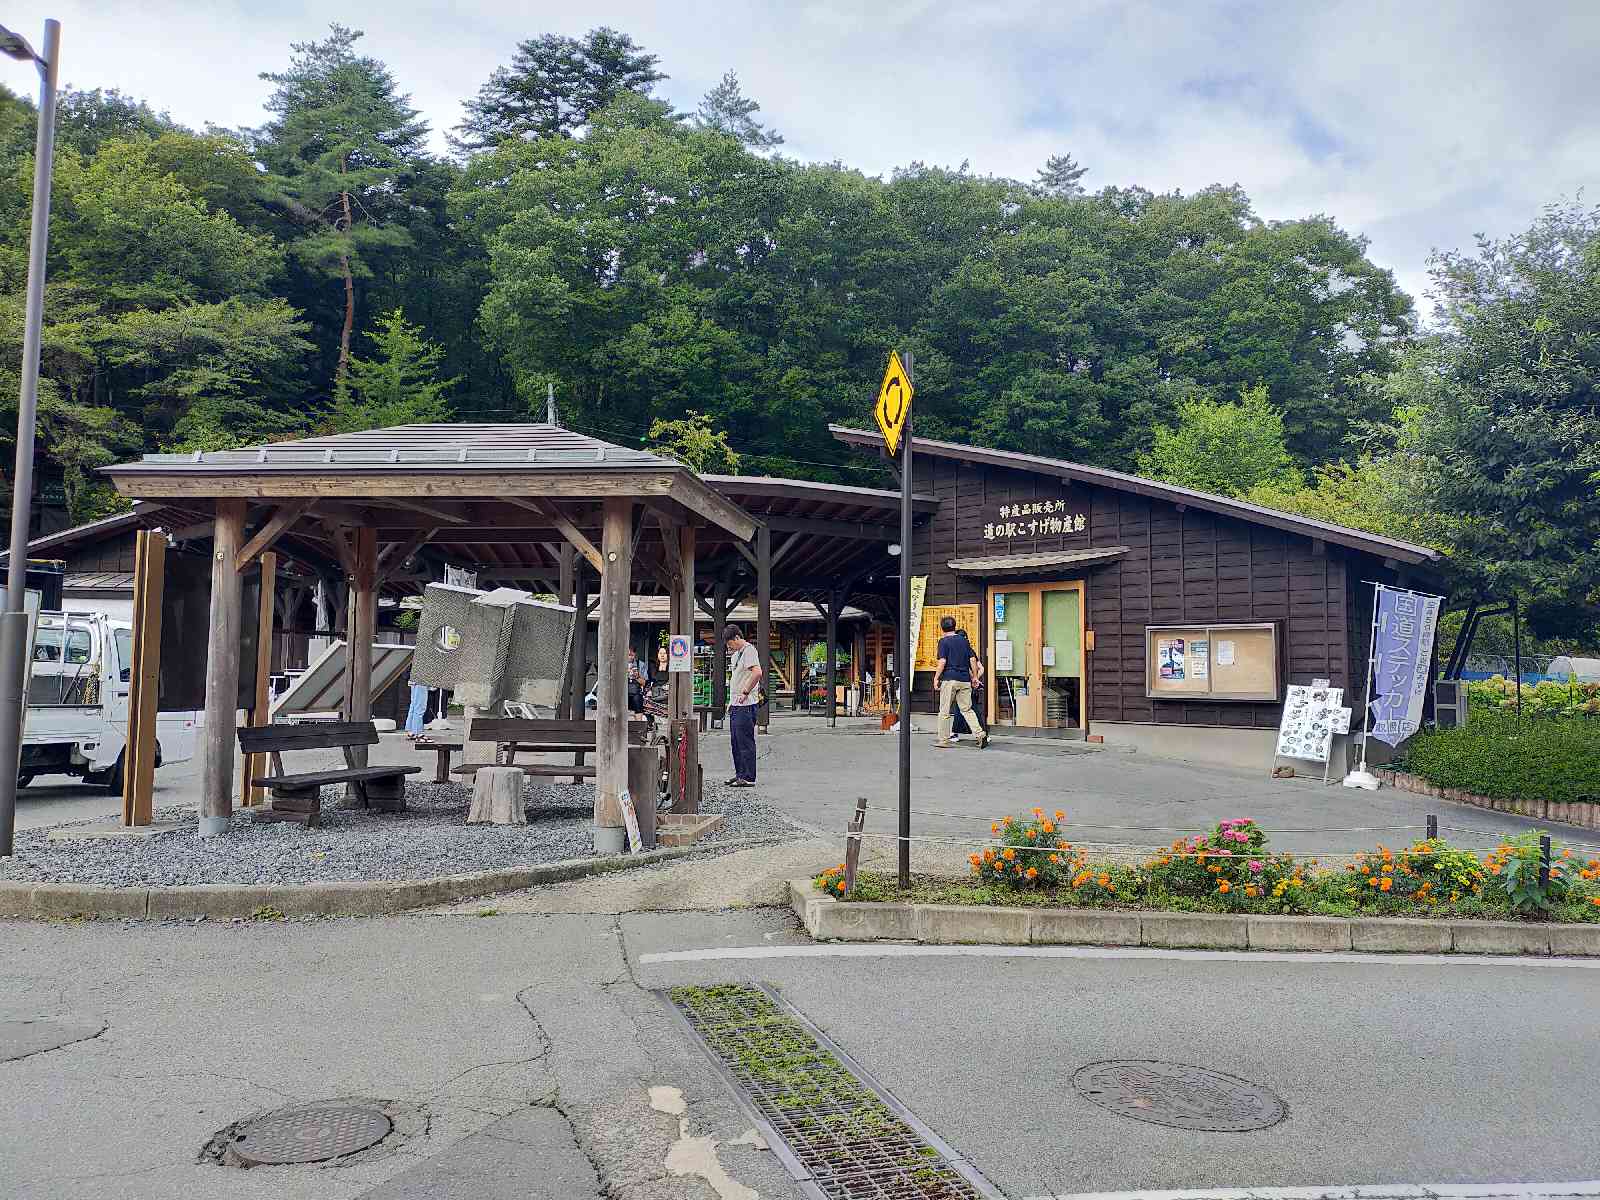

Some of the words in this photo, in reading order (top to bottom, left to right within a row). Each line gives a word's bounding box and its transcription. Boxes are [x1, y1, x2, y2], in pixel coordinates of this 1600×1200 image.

[999, 500, 1065, 519] 特産品販売所
[983, 514, 1086, 540] 道の駅こすげ物産館
[1384, 594, 1417, 722] 国道ステッカー
